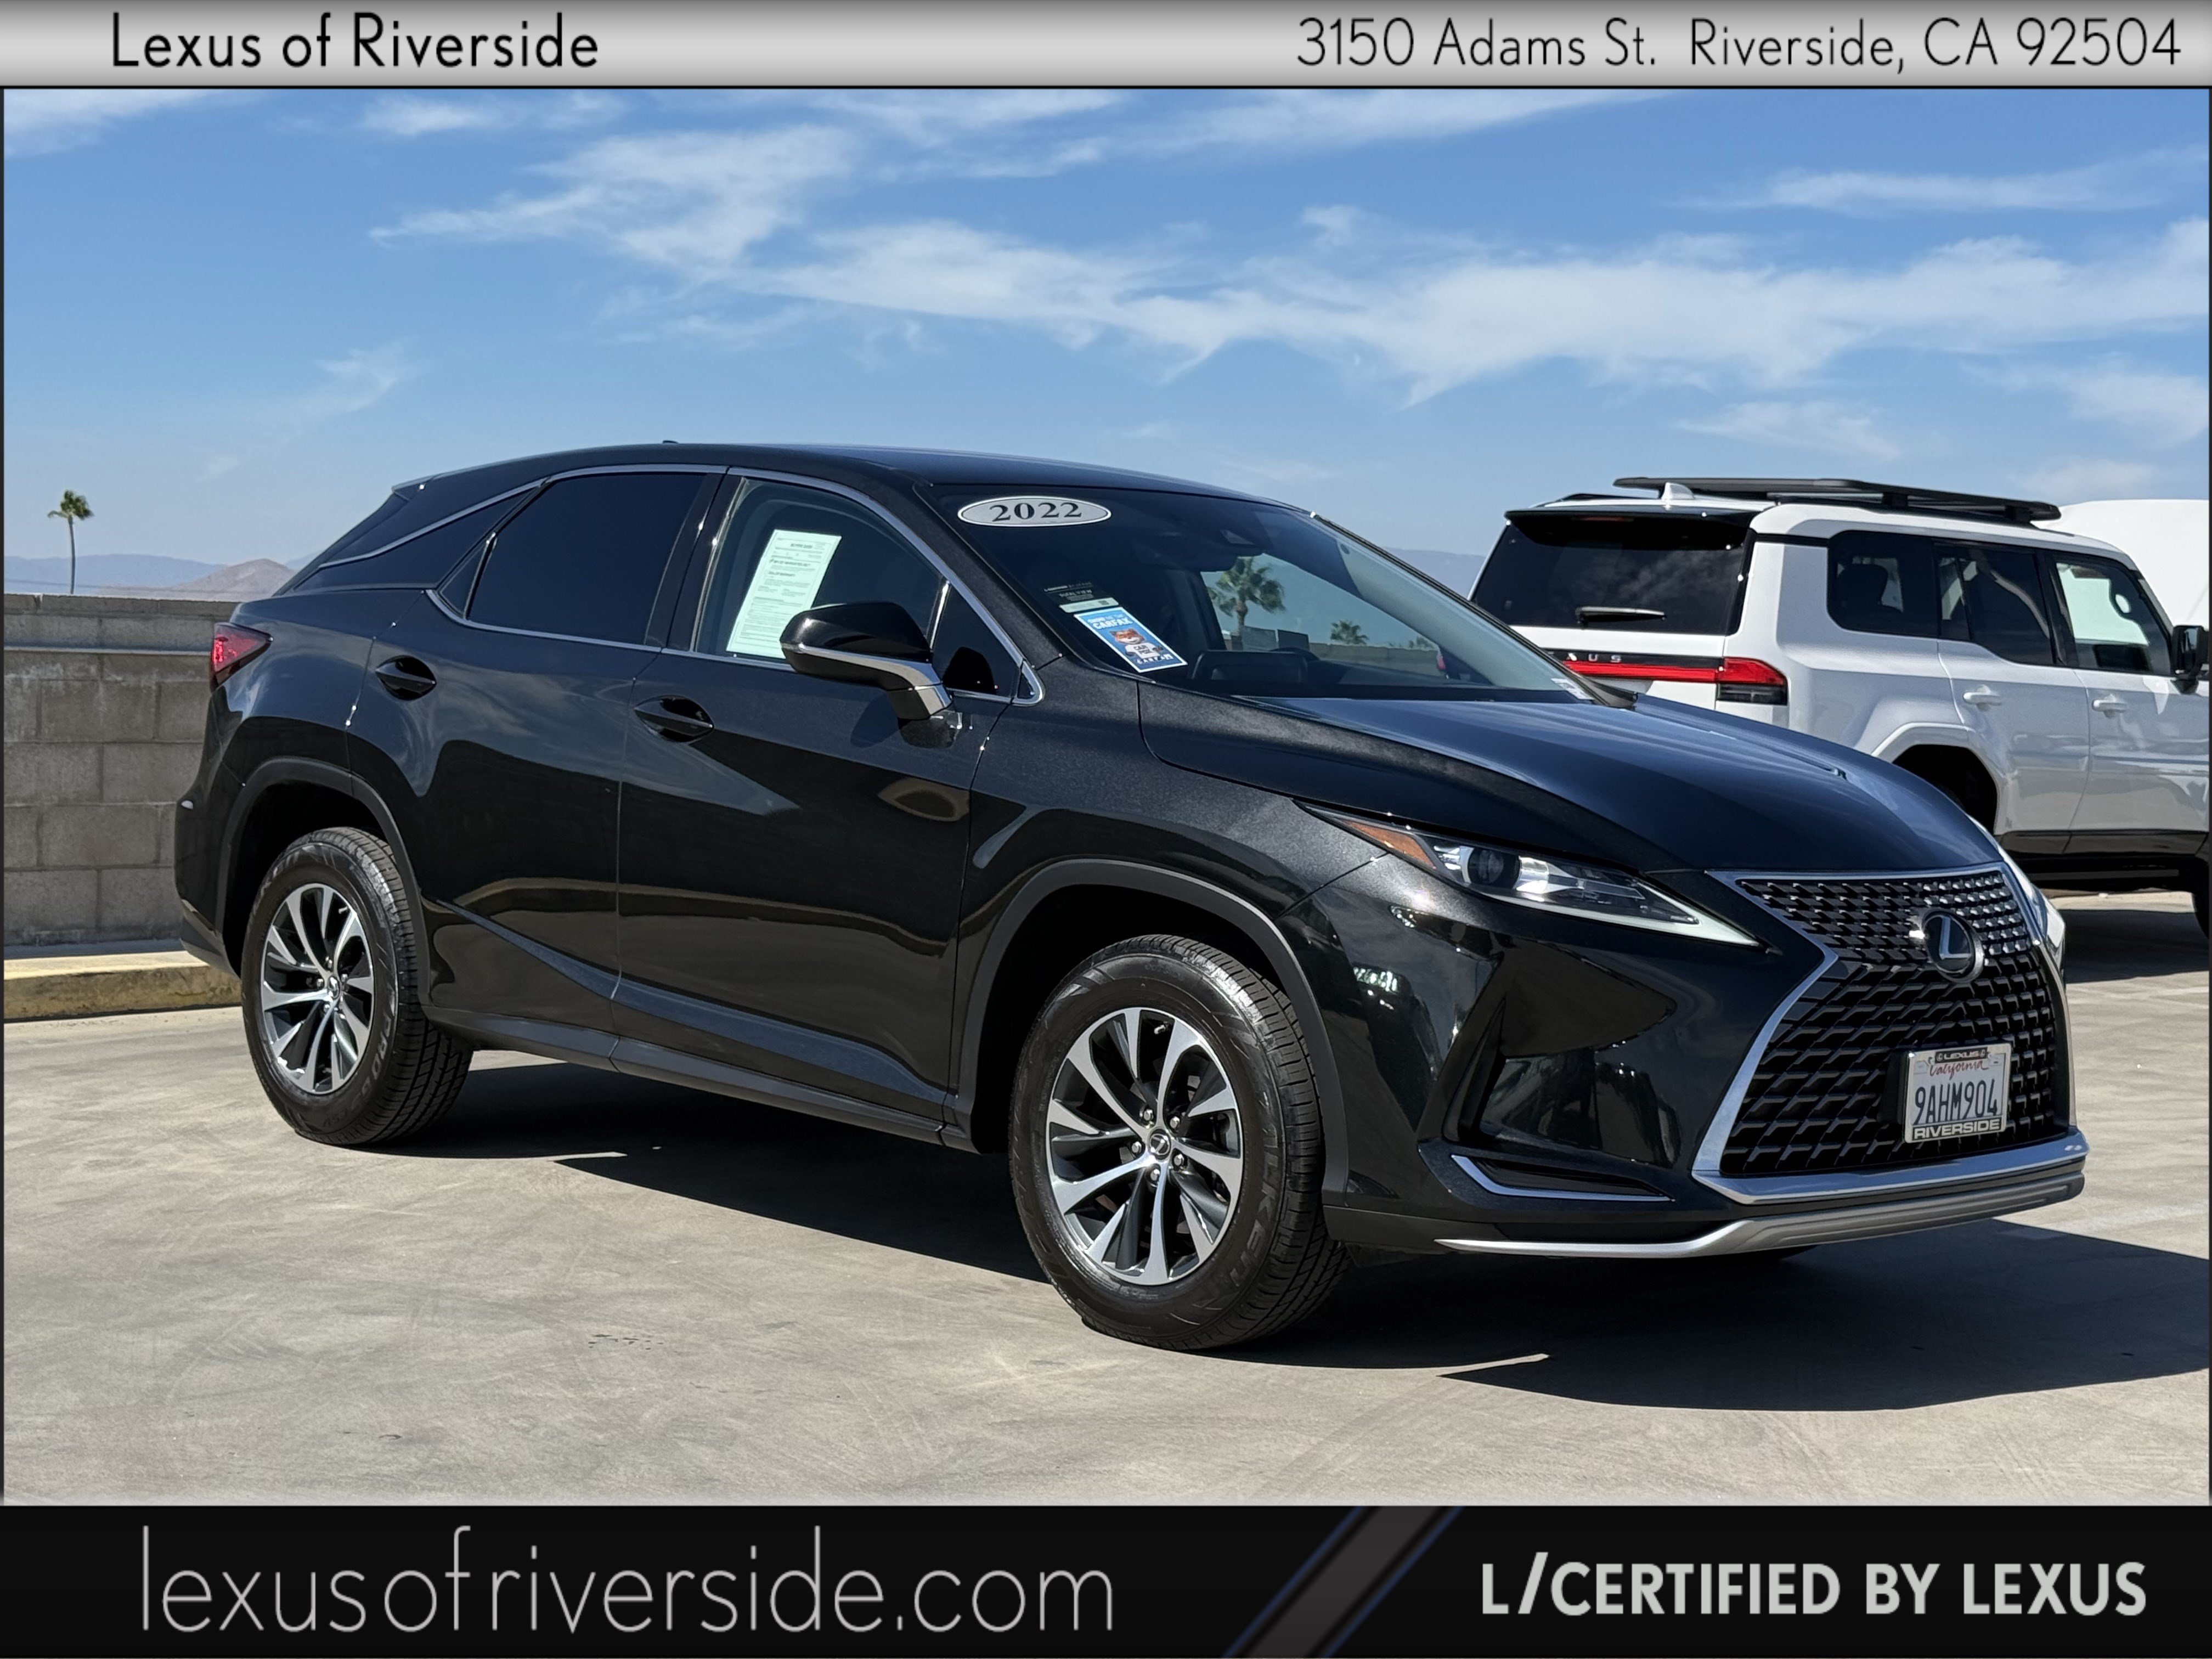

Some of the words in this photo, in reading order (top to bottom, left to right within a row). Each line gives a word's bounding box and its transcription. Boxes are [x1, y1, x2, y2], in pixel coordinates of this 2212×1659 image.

[989, 501, 1082, 522] 2022
[1092, 617, 1133, 629] CARFAX
[1944, 1050, 1979, 1060] LEXUS
[1929, 1060, 1989, 1081] California
[1912, 1079, 1997, 1126] 9AHM904
[1914, 1119, 2001, 1139] RIVERSIDE
